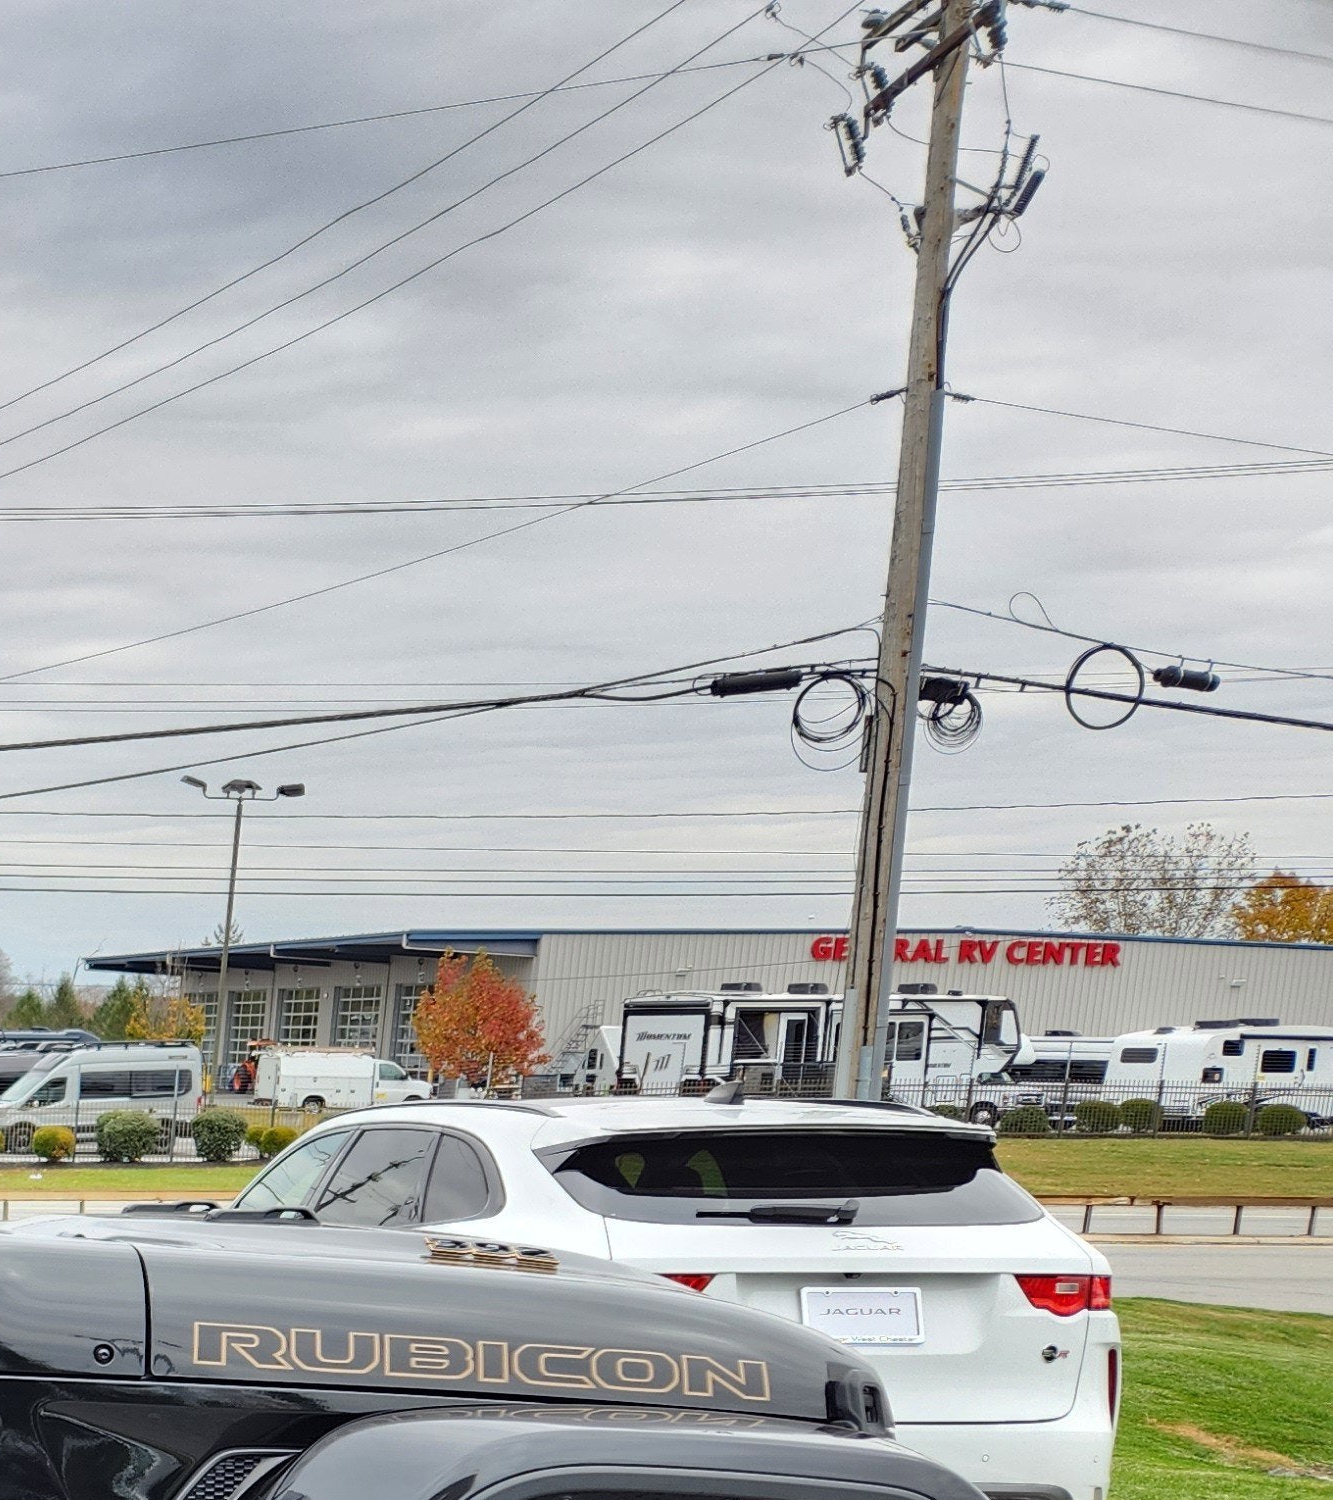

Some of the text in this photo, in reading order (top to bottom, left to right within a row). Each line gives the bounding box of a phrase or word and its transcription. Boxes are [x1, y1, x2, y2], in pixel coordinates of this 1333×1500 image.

[810, 936, 1121, 968] GERAL RV CENTER
[818, 1306, 903, 1317] JAGUAR
[192, 1321, 773, 1402] RUBICON
